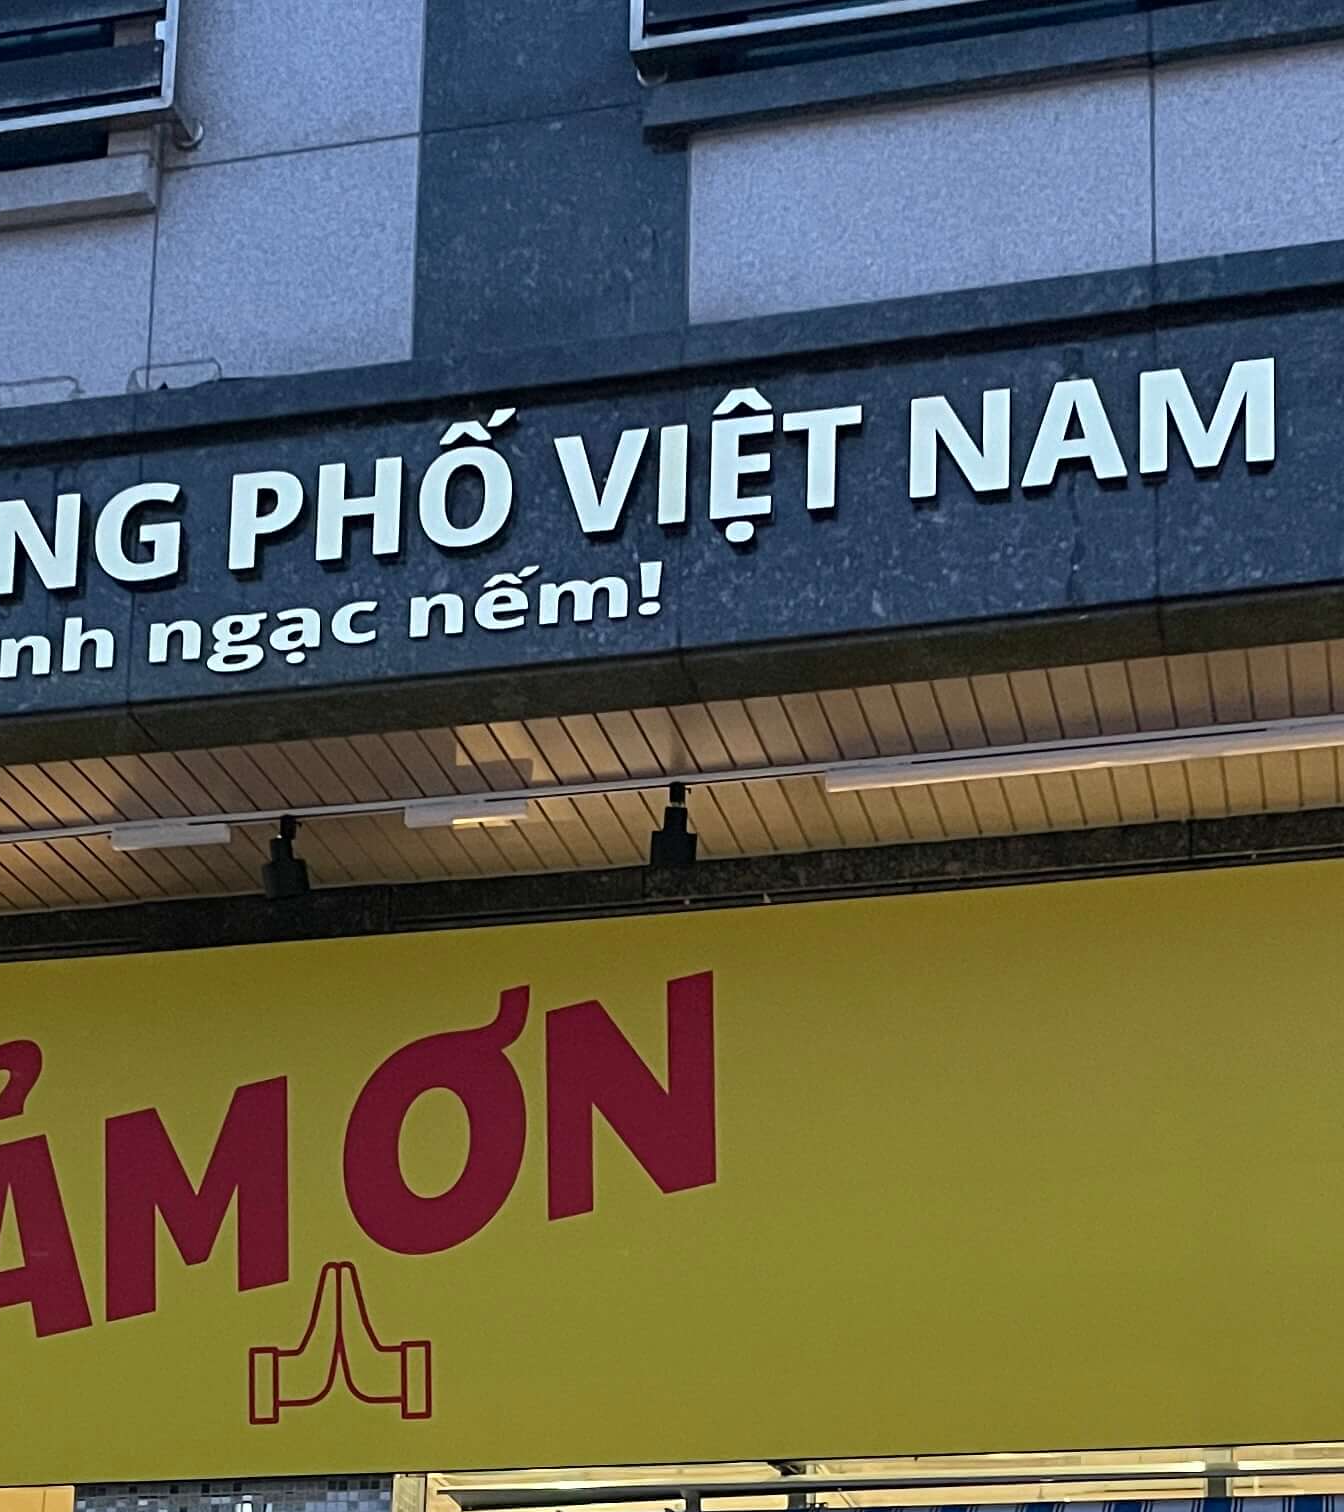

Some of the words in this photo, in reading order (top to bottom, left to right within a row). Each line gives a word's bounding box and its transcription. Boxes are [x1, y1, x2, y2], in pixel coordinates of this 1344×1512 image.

[227, 407, 517, 572] PHỐ
[553, 387, 862, 544] VIỆT
[909, 356, 1278, 501] NAM
[148, 597, 378, 673] ngạc
[409, 560, 664, 639] nếm!
[343, 969, 717, 1256] ƠN
